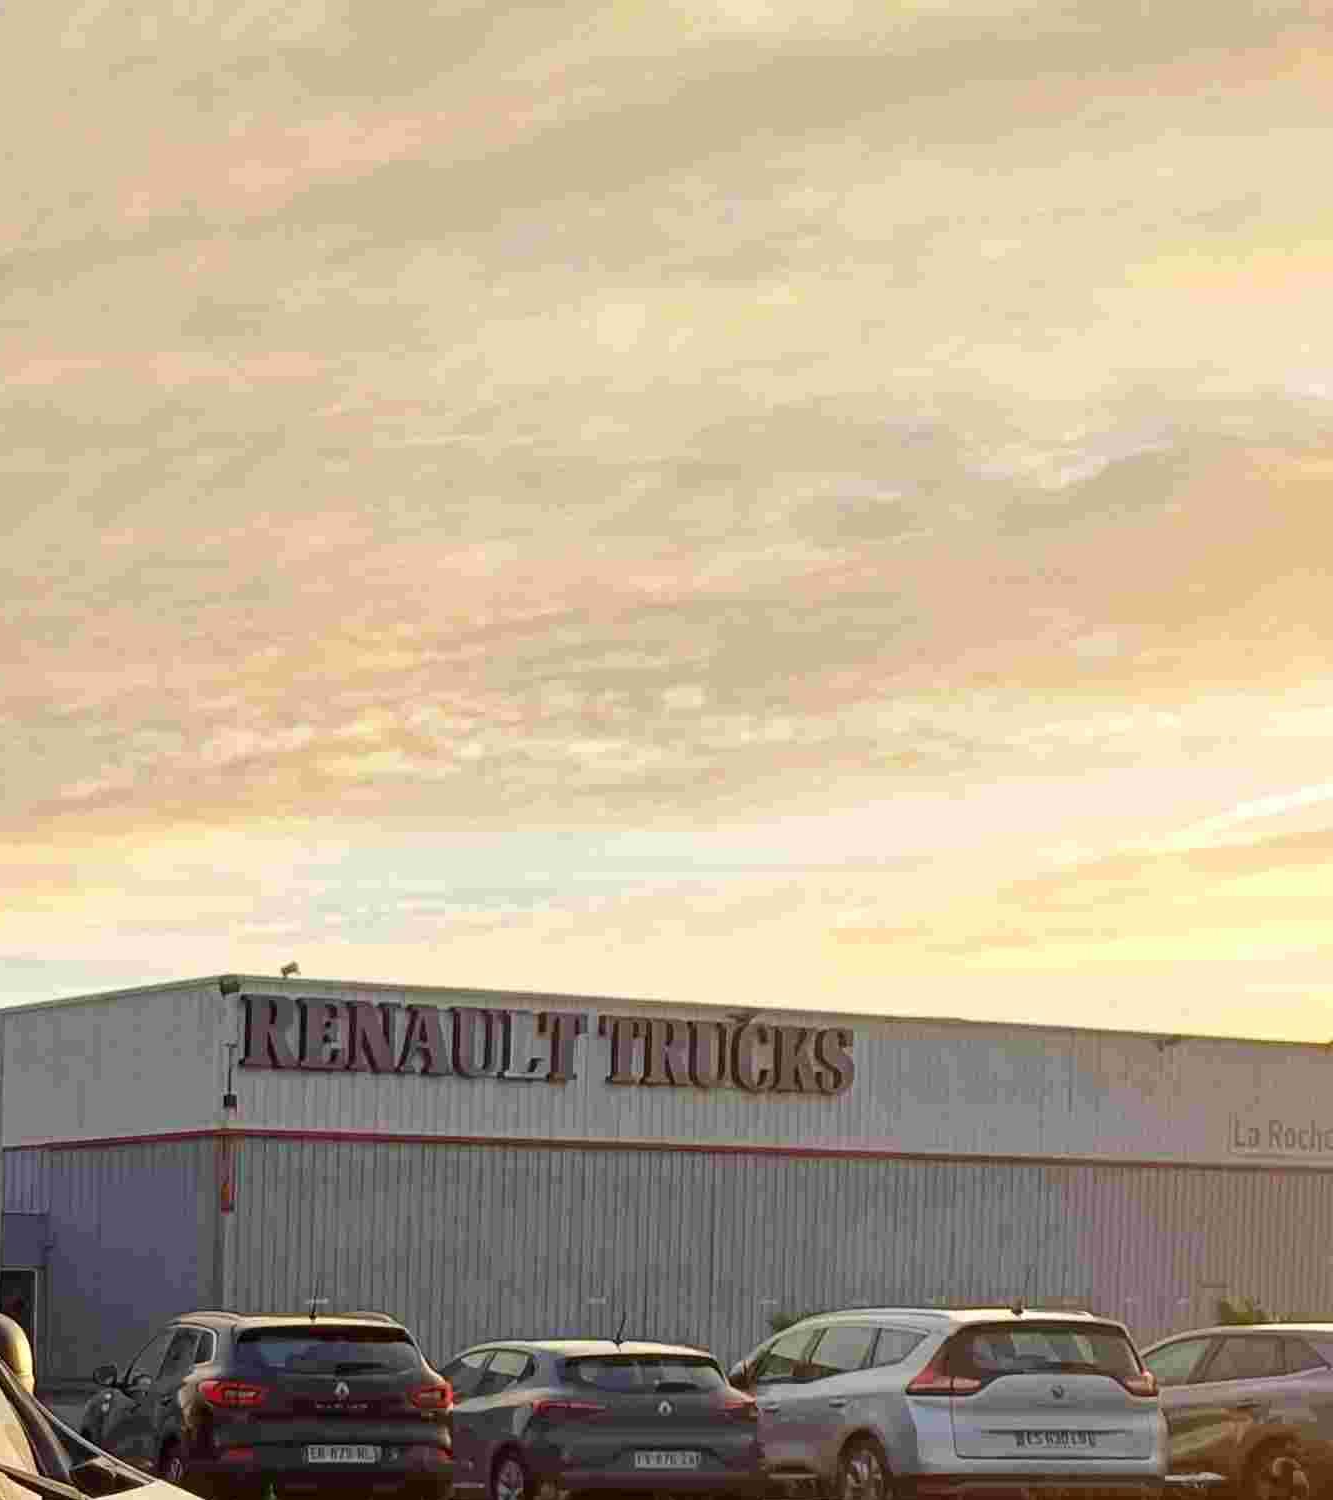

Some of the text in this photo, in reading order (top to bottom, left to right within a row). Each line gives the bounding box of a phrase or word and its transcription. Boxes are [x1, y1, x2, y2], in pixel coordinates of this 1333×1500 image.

[240, 993, 855, 1095] RENAULT TRUCKS
[1234, 1118, 1261, 1148] La
